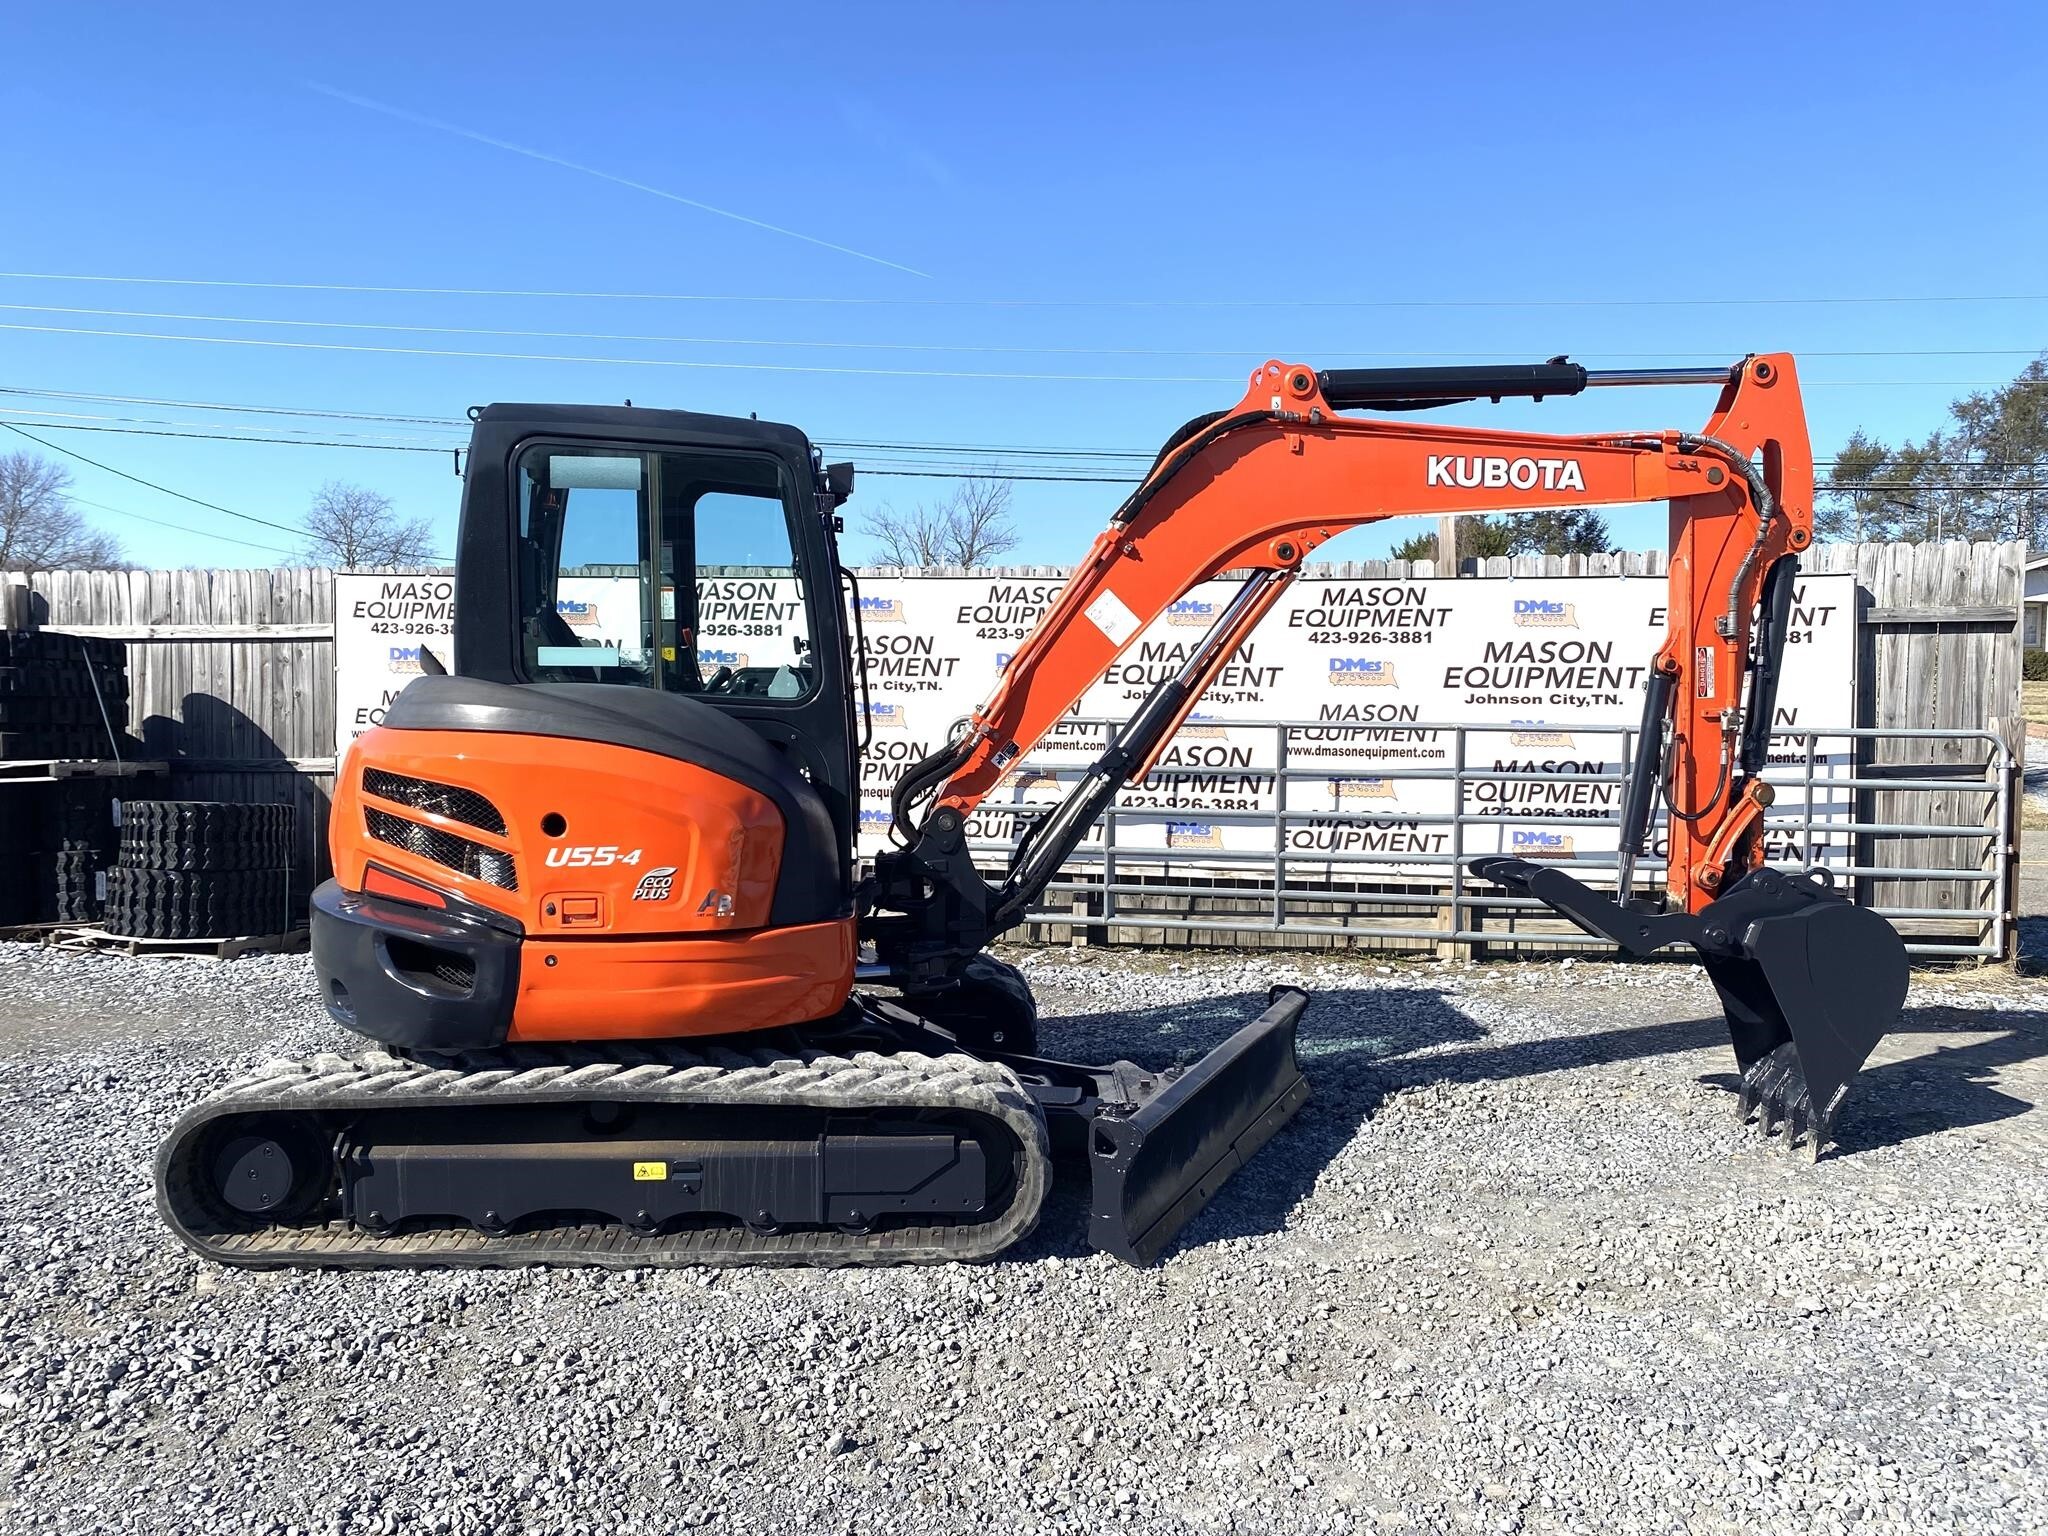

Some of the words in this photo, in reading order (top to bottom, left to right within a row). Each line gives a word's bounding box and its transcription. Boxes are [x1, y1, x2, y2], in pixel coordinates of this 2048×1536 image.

[1427, 455, 1587, 491] KUBOTA
[380, 582, 454, 600] MASO
[988, 585, 1064, 605] MASO
[1320, 586, 1427, 607] MASON
[352, 601, 455, 620] EQUIPME
[698, 602, 801, 620] IPMENT
[1288, 608, 1453, 628] EQUIPMENT
[698, 624, 783, 636] -926-3881
[1308, 631, 1433, 645] 423-926-3881
[389, 647, 421, 660] DM
[1482, 641, 1613, 664] MASON
[848, 657, 961, 677] IPMENT
[883, 680, 943, 693] City,TN.
[1442, 666, 1645, 689] EQUIPMENT
[1464, 693, 1543, 705] Johnson
[1549, 693, 1625, 708] City,TN.
[1318, 703, 1420, 722] MASON
[1287, 727, 1440, 743] EQUIPMENT
[858, 741, 929, 761] ASON
[1154, 745, 1253, 768] ASON
[1121, 795, 1260, 811] 423-926-3881
[643, 876, 674, 889] eco
[631, 887, 671, 901] PLUS
